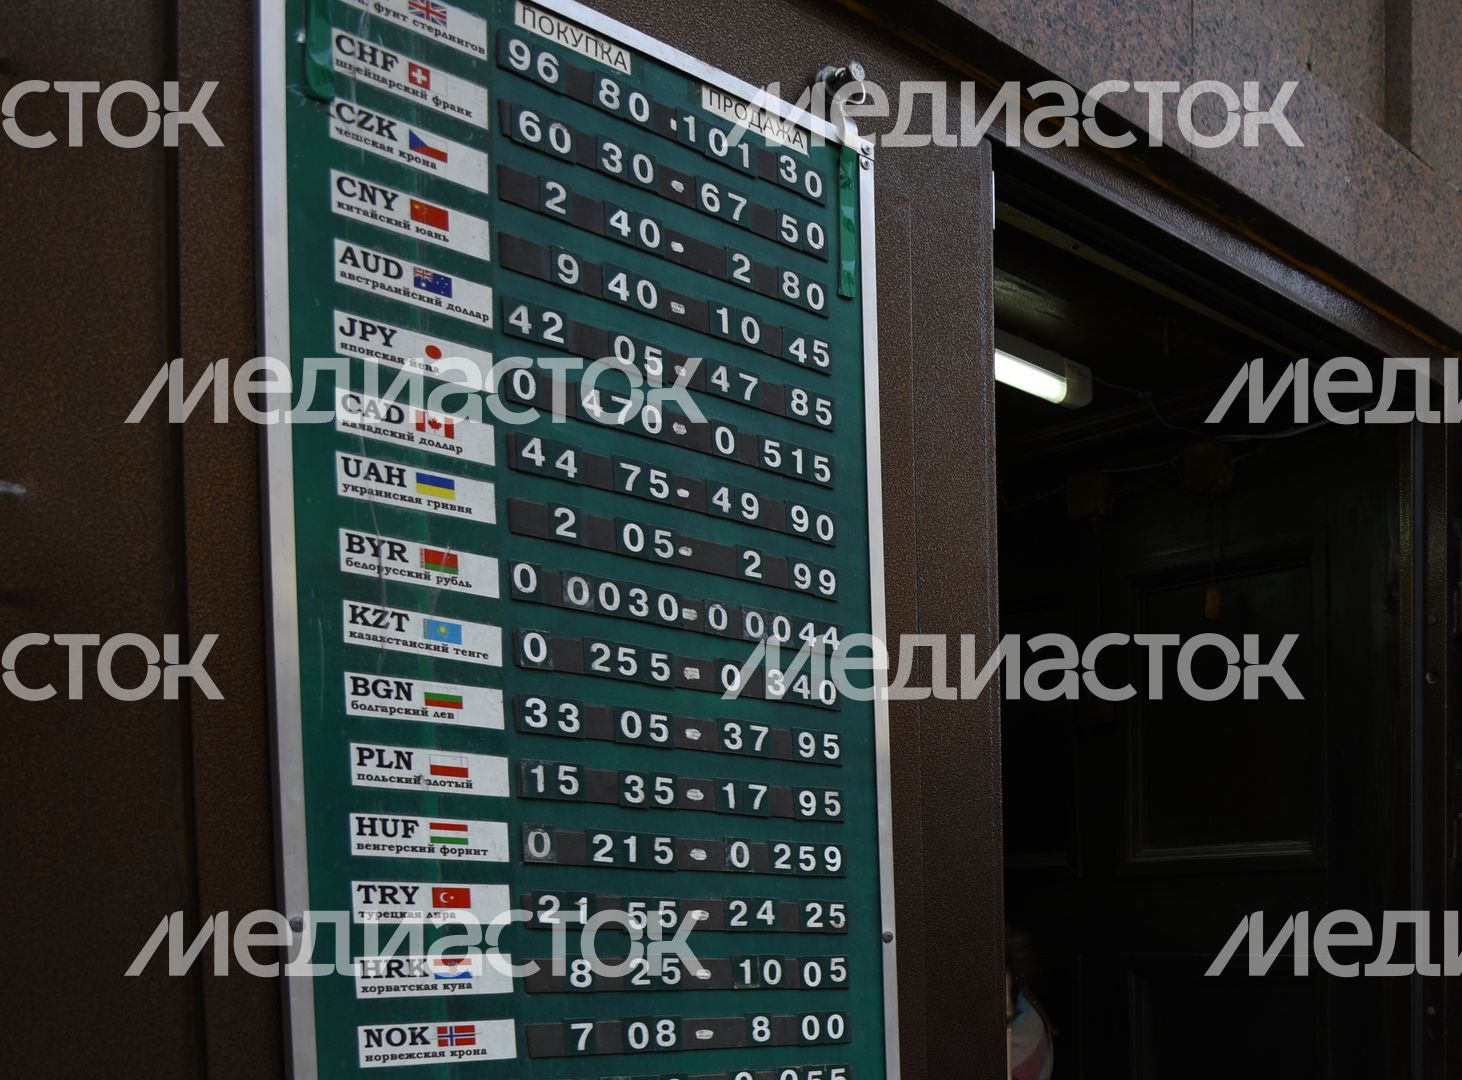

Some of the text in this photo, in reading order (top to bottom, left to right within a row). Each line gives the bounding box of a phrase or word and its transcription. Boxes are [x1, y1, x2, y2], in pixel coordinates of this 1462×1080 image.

[373, 3, 486, 55] фунт стерлингов
[521, 5, 629, 72] ПОКУПКА
[335, 34, 399, 73] CHF
[335, 102, 398, 142] CZK
[431, 95, 473, 118] франк
[708, 88, 805, 150] ПРОДАЖА
[335, 126, 437, 170] чешская крона
[336, 176, 399, 212] CNY
[519, 110, 825, 250] 60 30 67 50
[336, 200, 450, 243] китайский юань
[545, 181, 825, 310] 2 40 2 80
[339, 245, 404, 280] AUD
[339, 270, 490, 323] австралийский доллар
[558, 253, 830, 368] 9 40 10 45
[339, 317, 398, 348] JPY
[340, 342, 405, 365] японская
[341, 393, 406, 425] CAD
[418, 437, 463, 454] доллар
[340, 456, 407, 488] UAH
[342, 482, 473, 515] украинская гривня
[345, 532, 409, 564] BYR
[345, 556, 473, 588] белорусский рубль
[348, 604, 410, 633] KZT
[348, 630, 489, 660] казахстанский тенге
[350, 675, 414, 702] BGN
[350, 699, 455, 720] болгарский лев
[525, 697, 840, 760] 33 05 37 95
[356, 746, 414, 771] PLN
[356, 773, 474, 789] польский злотый
[355, 816, 420, 839] HUF
[356, 842, 489, 858] венгерский форинт
[528, 831, 842, 872] 0 215 0 259
[356, 884, 420, 905] TRY
[359, 958, 430, 980] HRK
[361, 982, 473, 995] хорватская куна
[363, 1026, 431, 1048] NOK
[571, 1014, 844, 1051] 7 08 8 00
[364, 1048, 487, 1064] норвежская крона
